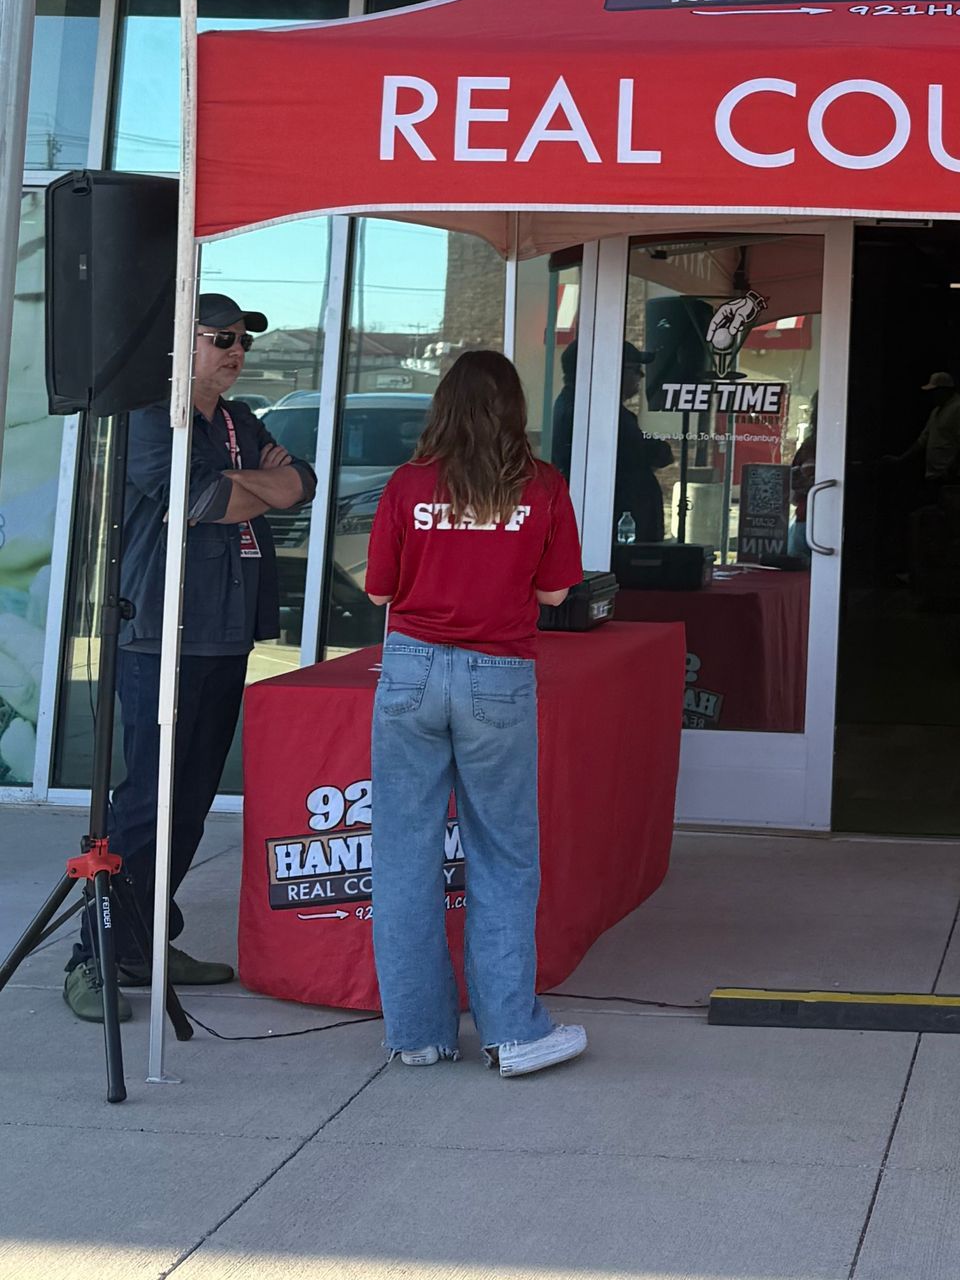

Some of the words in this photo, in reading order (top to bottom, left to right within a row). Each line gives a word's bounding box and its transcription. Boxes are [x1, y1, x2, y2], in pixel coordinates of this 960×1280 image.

[379, 75, 662, 164] REAL
[661, 383, 712, 410] TEE
[717, 384, 782, 412] TIME
[642, 431, 651, 440] To
[306, 779, 372, 831] 92
[287, 881, 335, 900] REAL
